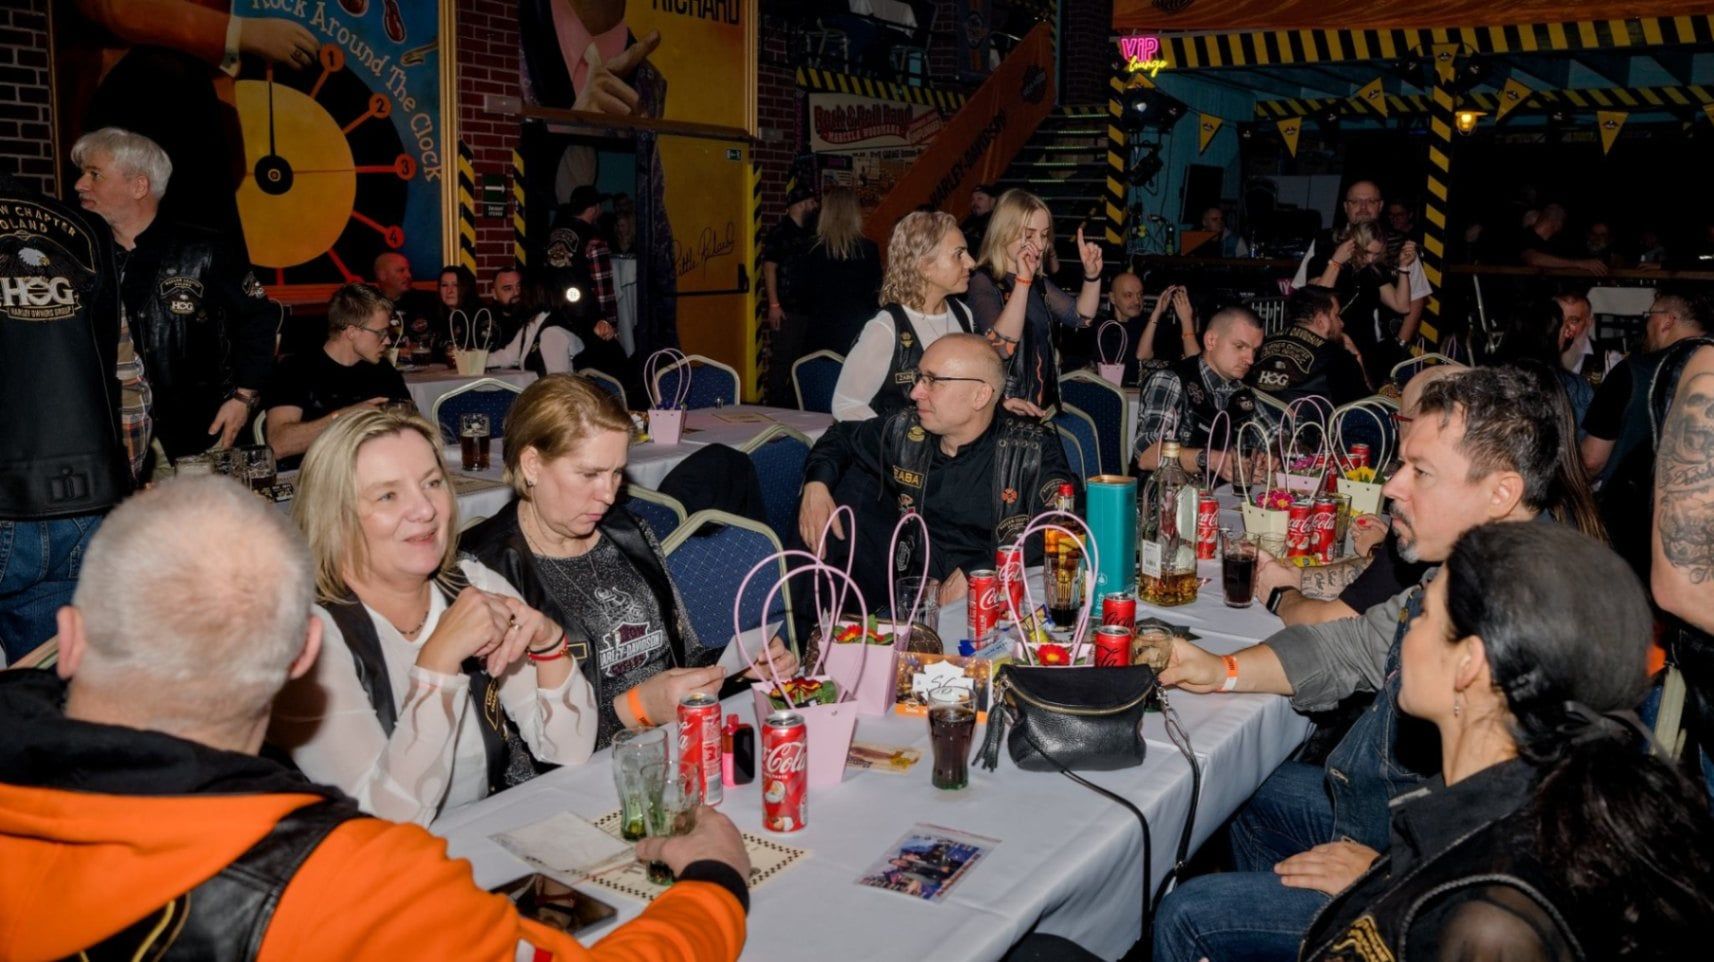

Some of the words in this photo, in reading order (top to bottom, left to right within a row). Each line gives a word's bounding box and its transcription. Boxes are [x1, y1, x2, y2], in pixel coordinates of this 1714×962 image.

[309, 2, 391, 77] Around
[385, 64, 416, 112] The
[410, 112, 442, 182] Clock
[375, 98, 387, 113] 2
[401, 158, 409, 174] 3
[0, 219, 48, 233] OLAND
[15, 206, 77, 237] CHAPTER
[2, 276, 76, 307] HOG
[1258, 370, 1290, 387] HOG
